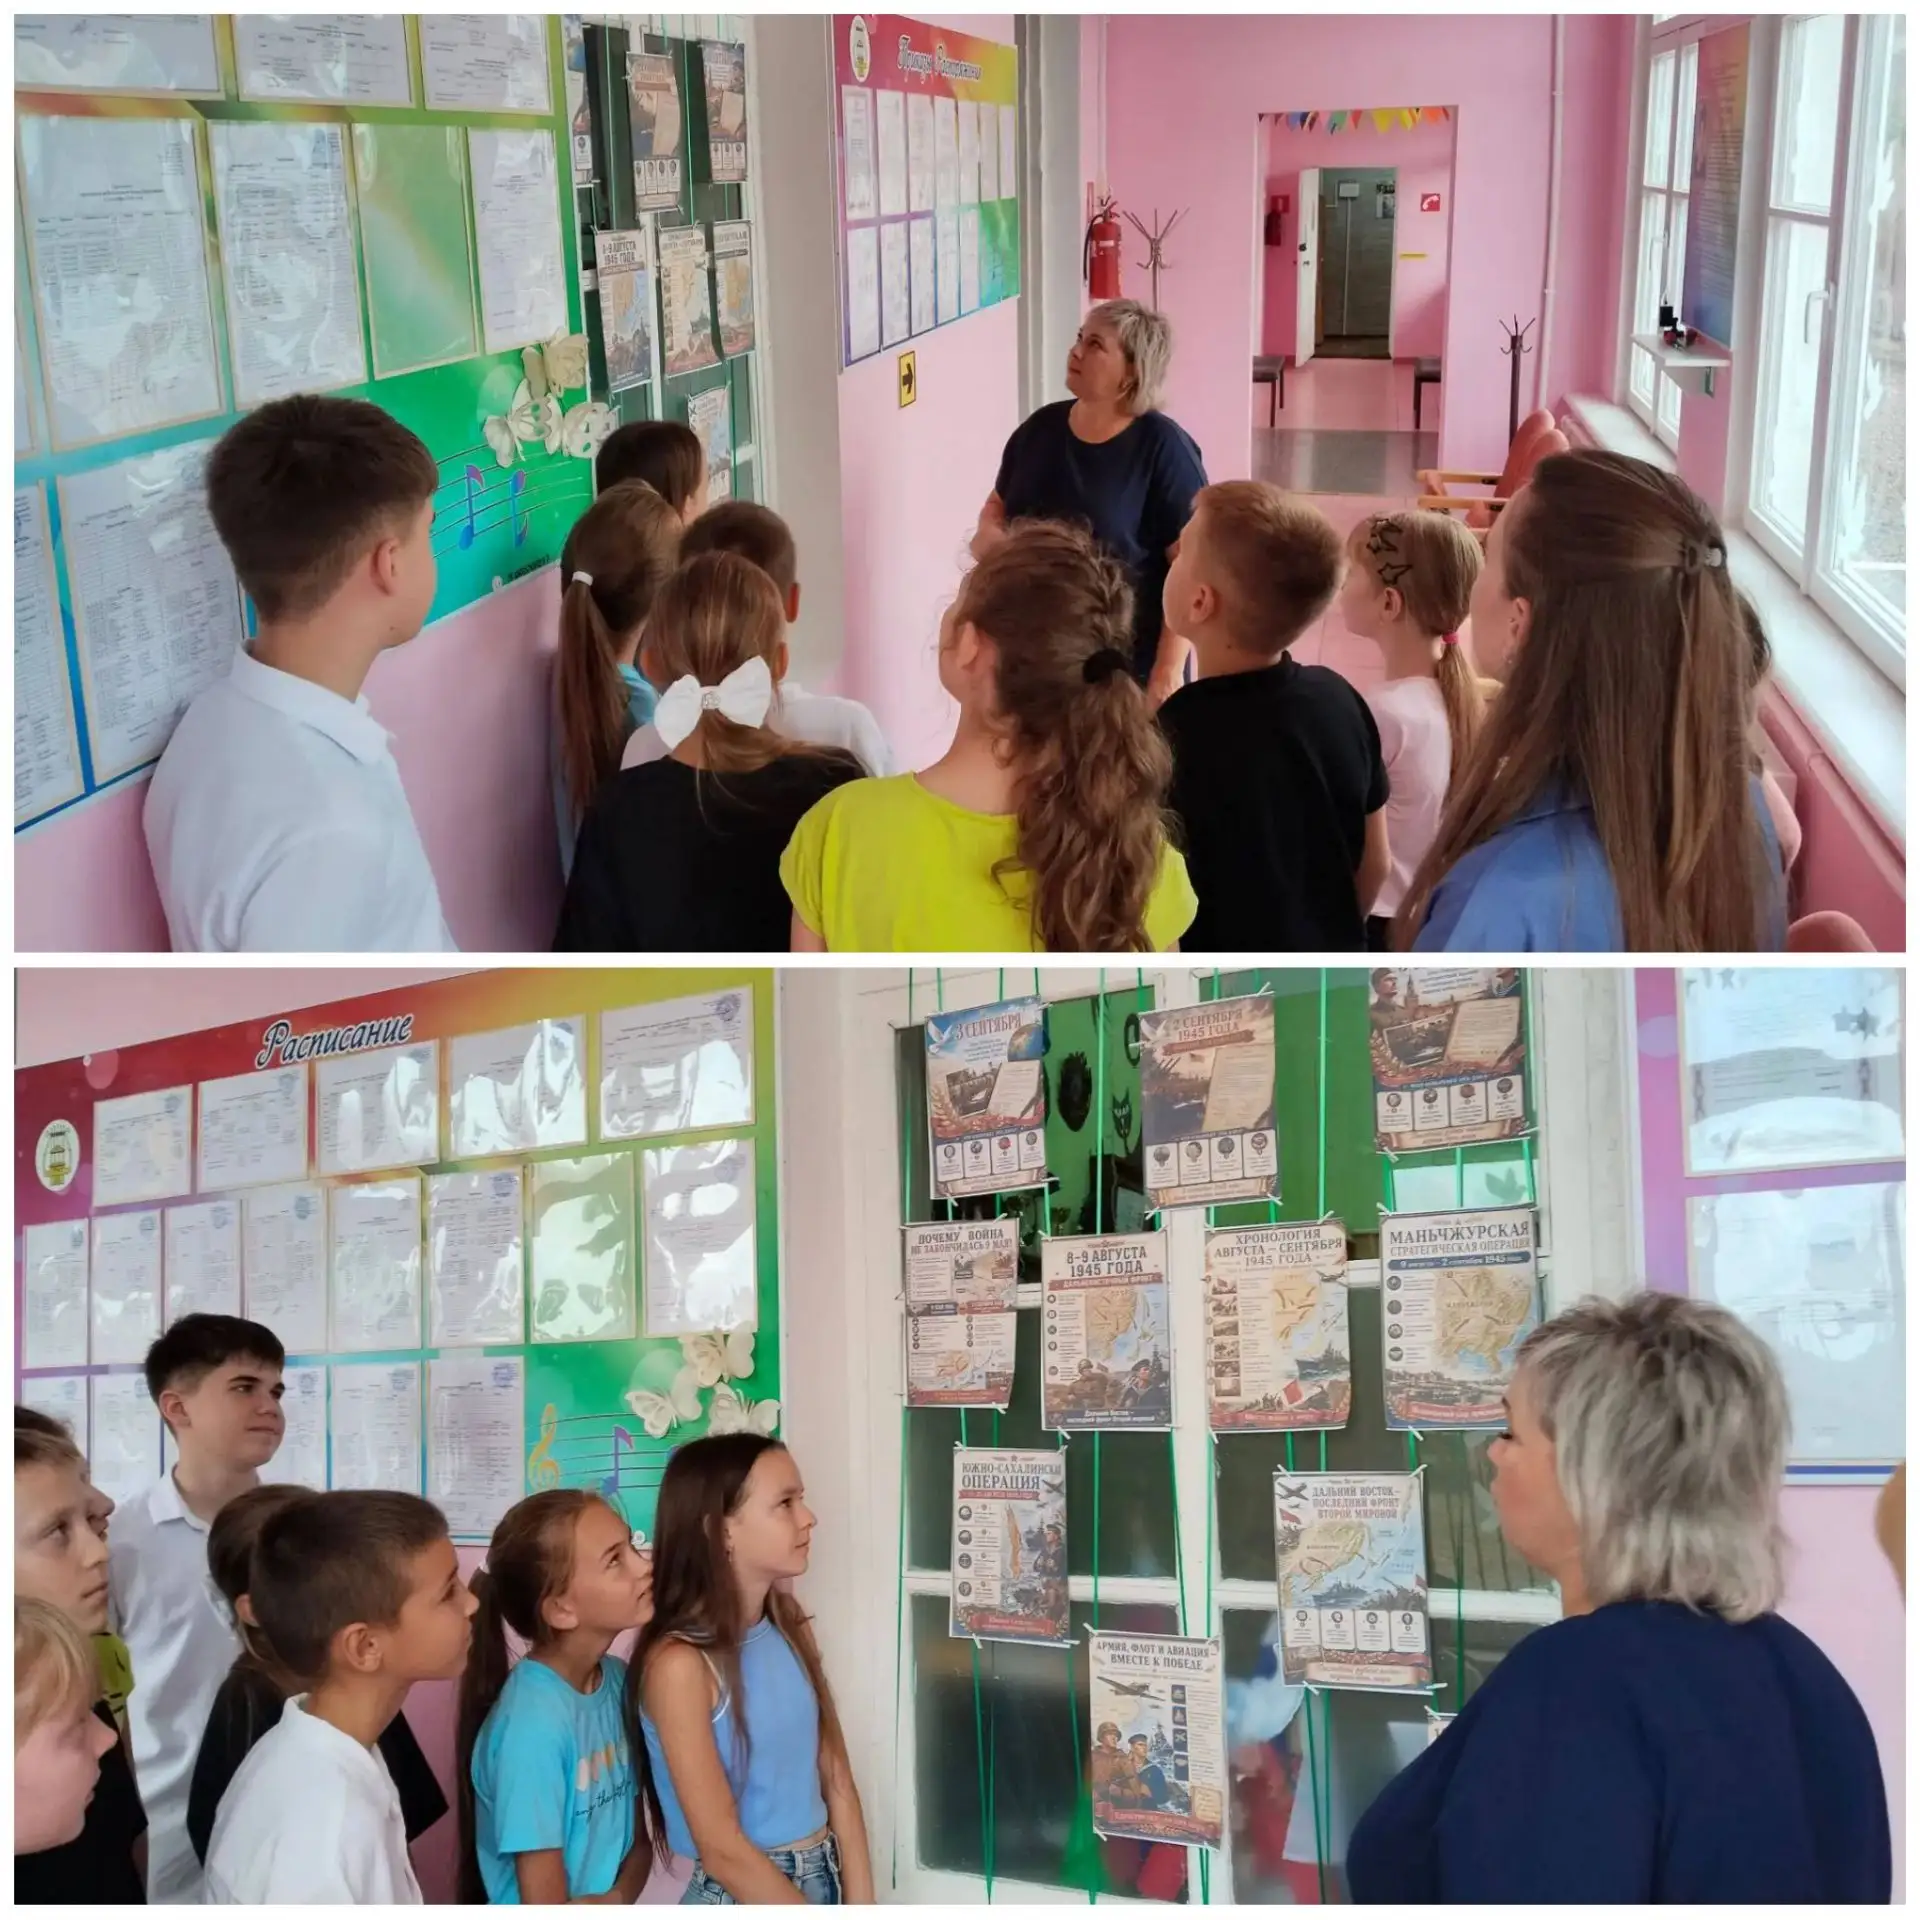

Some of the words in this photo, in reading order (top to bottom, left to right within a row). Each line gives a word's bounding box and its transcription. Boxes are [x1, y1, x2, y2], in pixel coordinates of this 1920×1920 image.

[956, 1023, 964, 1041] 3
[965, 1012, 1021, 1039] СЕНТЯБРЯ
[1173, 1019, 1180, 1030] 2
[1183, 1008, 1243, 1029] СЕНТЯБРЯ
[1178, 1026, 1205, 1041] 1945
[1207, 1021, 1239, 1036] ГОДА
[255, 1014, 413, 1068] Расписание
[918, 1231, 961, 1245] ПОЧЕМУ
[968, 1228, 1004, 1241] ВОЙНА
[1235, 1228, 1321, 1245] ХРОНОЛОГИЯ
[1390, 1220, 1529, 1244] МАНЬЧЖУРСКАЯ
[924, 1241, 985, 1254] ЗАКОНЧИЛАСЬ
[1092, 1245, 1147, 1263] АВГУСТА
[1214, 1244, 1265, 1258] АВГУСТА
[1279, 1237, 1342, 1254] СЕНТЯБРЯ
[1390, 1242, 1478, 1257] СТРАТЕГИЧЕСКАЯ
[1245, 1255, 1273, 1267] 1945
[1278, 1252, 1312, 1265] ГОДА
[1071, 1262, 1101, 1278] 1945
[1107, 1259, 1144, 1275] ГОДА
[961, 1474, 1040, 1490] ОПЕРАЦИЯ
[1312, 1486, 1357, 1497] ДАЛЬНИЙ
[1313, 1497, 1368, 1508] ПОСЛЕДНИЙ
[1370, 1497, 1400, 1508] ФРОНТ
[1317, 1508, 1352, 1519] ВТОРОЙ
[1355, 1508, 1398, 1519] МИРОВОЙ
[1096, 1641, 1129, 1654] АРМИЯ,
[1130, 1643, 1156, 1654] ФЛОТ
[1167, 1645, 1210, 1658] АВИАЦИЯ
[1110, 1654, 1150, 1666] ВМЕСТЕ
[1152, 1656, 1160, 1667] К
[1163, 1657, 1203, 1670] ПОБЕДЕ
